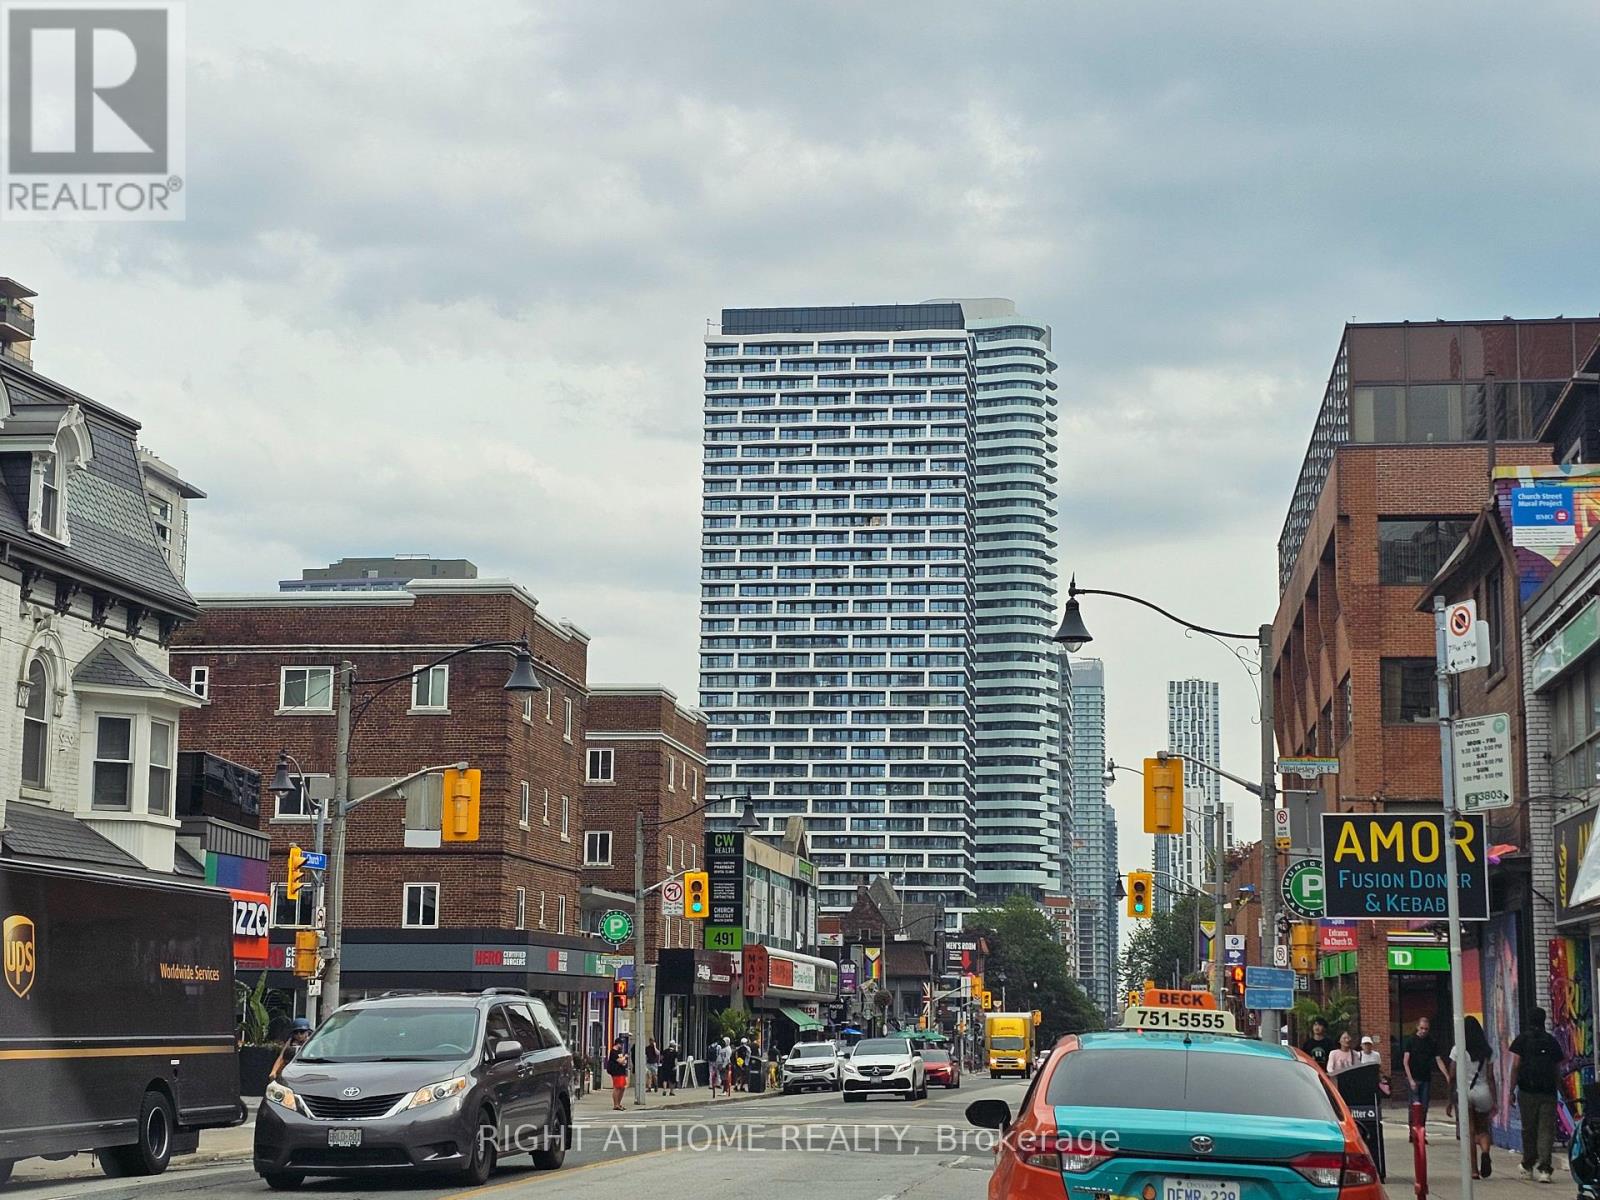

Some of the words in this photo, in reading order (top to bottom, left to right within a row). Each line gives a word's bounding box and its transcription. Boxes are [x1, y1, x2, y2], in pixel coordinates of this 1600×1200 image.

[1540, 500, 1563, 508] Project
[1465, 720, 1485, 728] PARKING
[1479, 790, 1503, 801] 3803
[714, 834, 735, 847] CW
[1333, 821, 1476, 863] AMOR
[1339, 870, 1404, 889] FUSION
[1410, 870, 1472, 889] DONR
[1365, 893, 1381, 913] &
[1386, 893, 1447, 913] KEBAB
[713, 932, 735, 946] 491
[946, 942, 961, 951] MEN'S
[962, 942, 977, 951] ROOM
[6, 941, 33, 985] ups
[502, 958, 526, 966] BURGERS
[1389, 950, 1412, 966] TD
[160, 962, 193, 980] Worldwide
[195, 964, 220, 981] Services
[1159, 992, 1204, 1006] BECK
[1137, 1010, 1225, 1029] 751-5555
